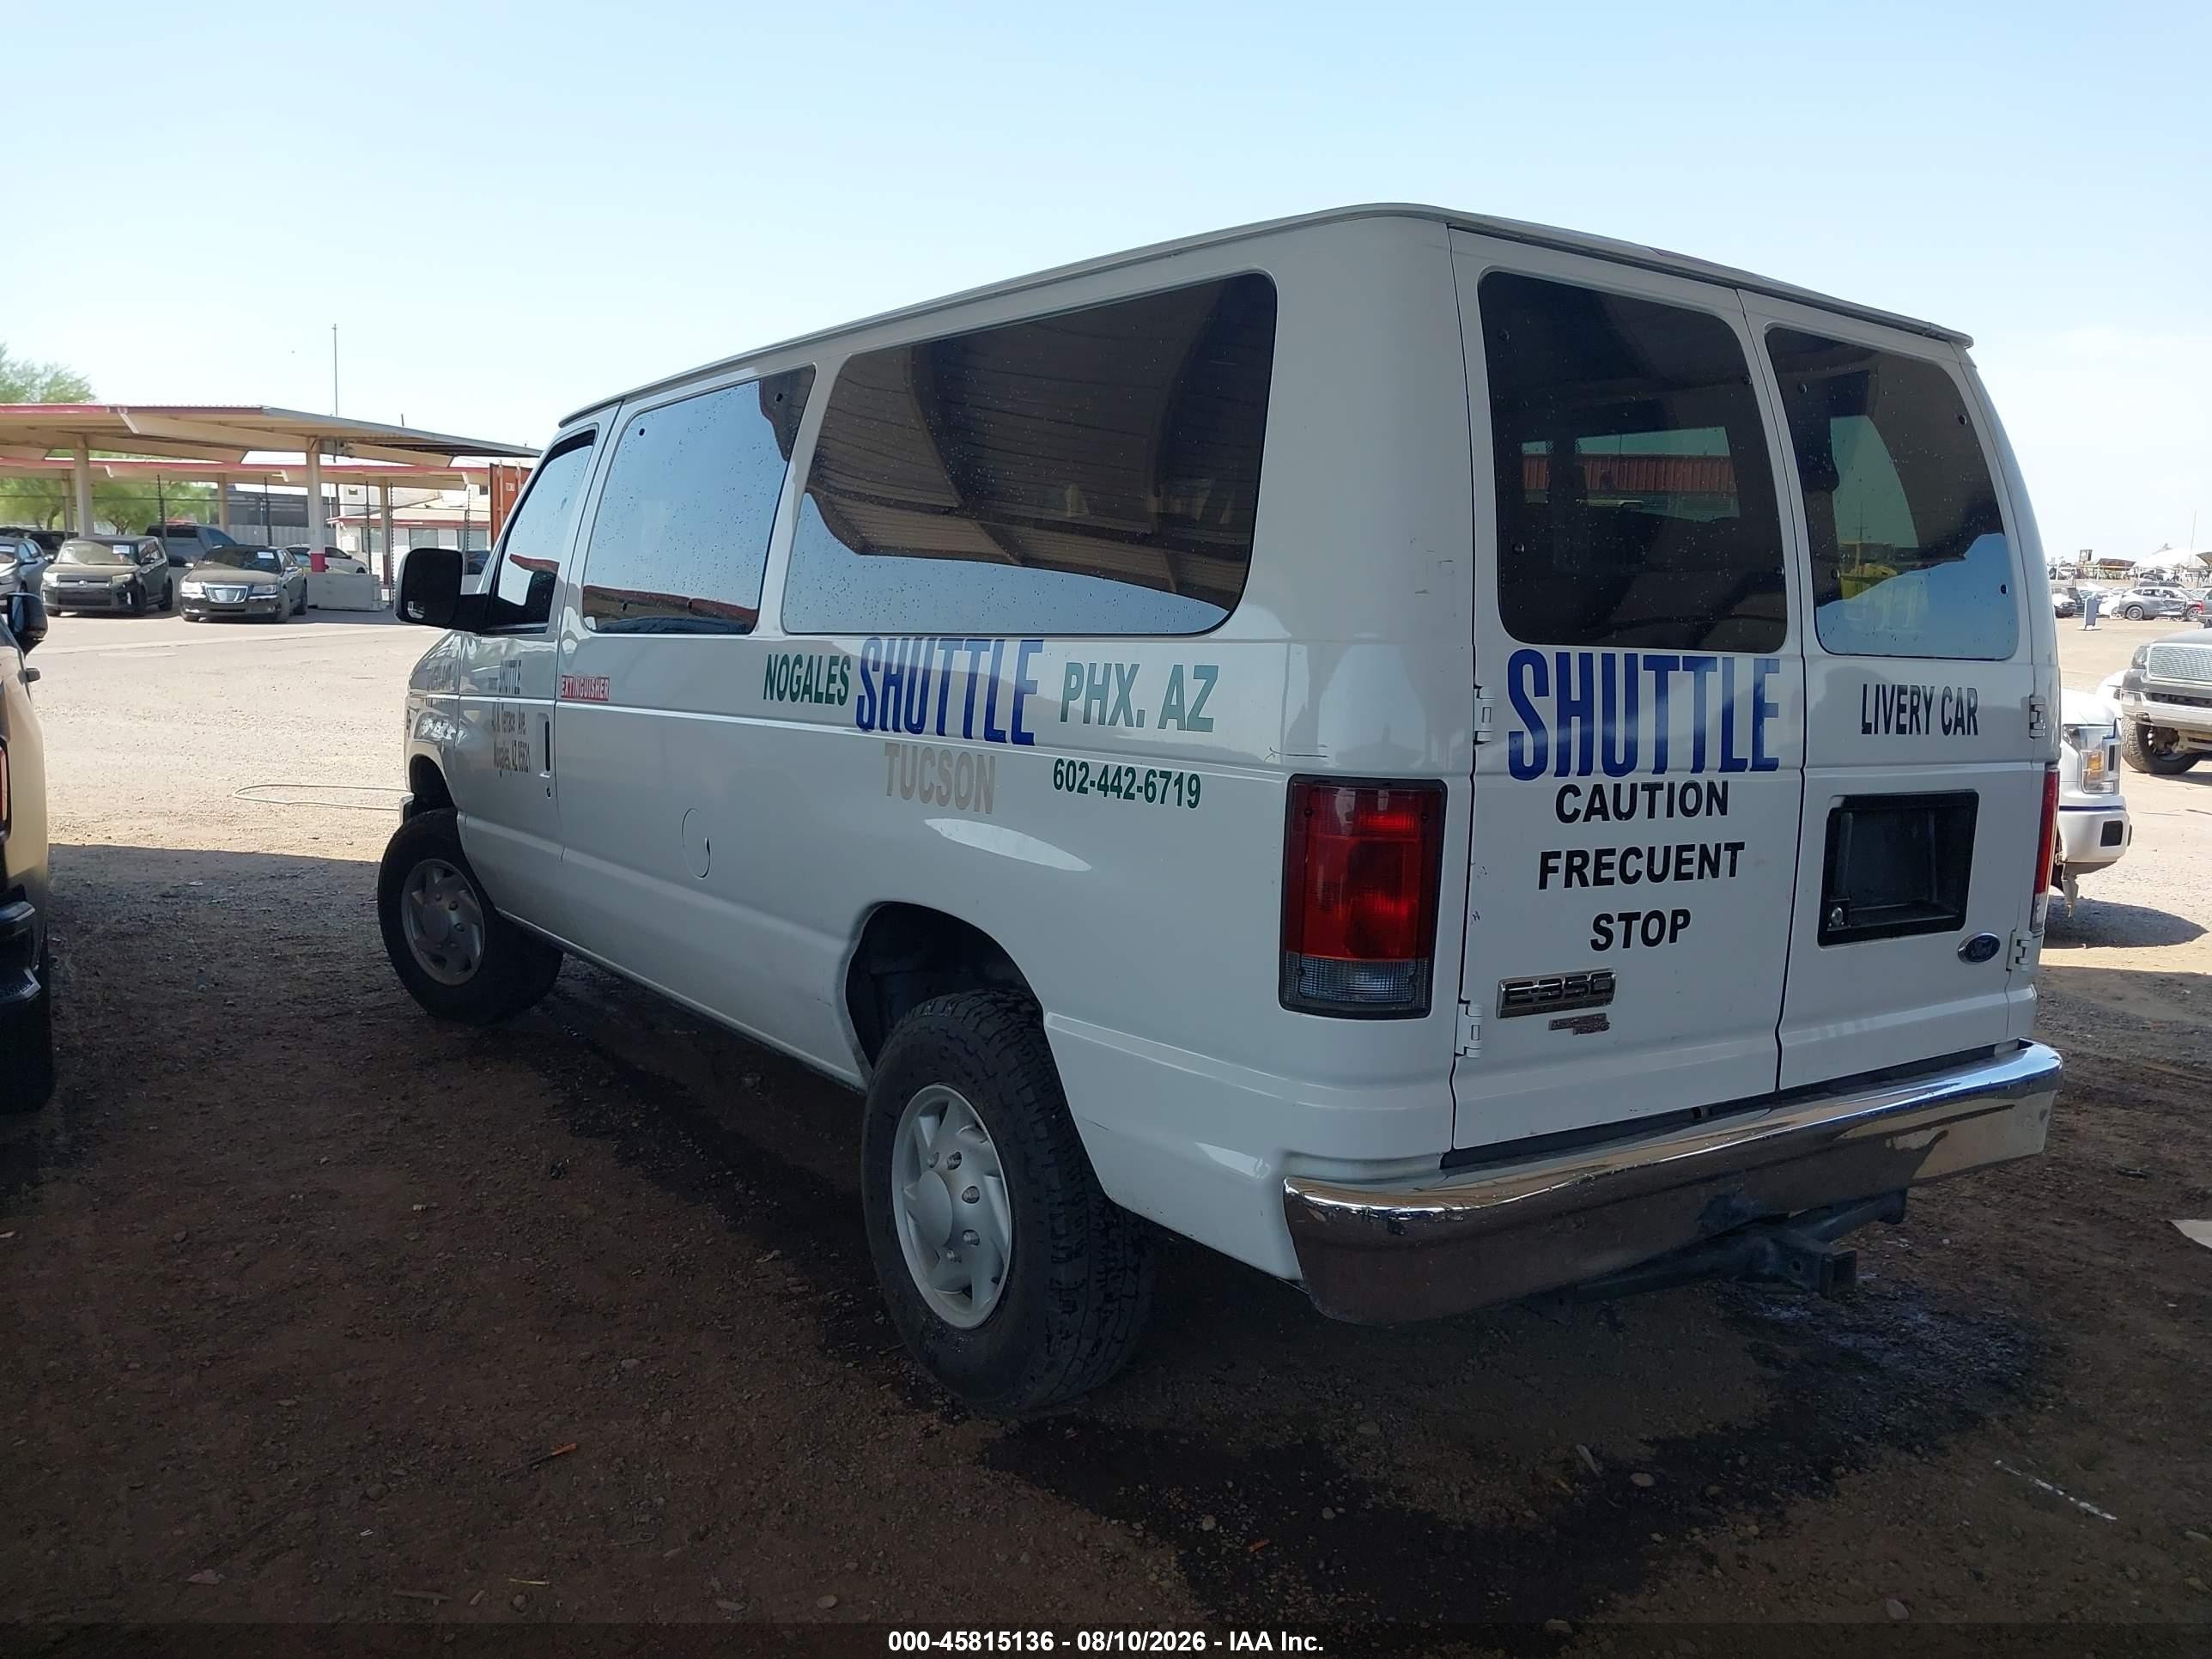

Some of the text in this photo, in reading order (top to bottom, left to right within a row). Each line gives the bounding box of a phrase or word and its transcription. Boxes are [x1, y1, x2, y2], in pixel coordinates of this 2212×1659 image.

[562, 676, 610, 701] EXTINGUISHER
[763, 636, 1220, 746] NOGALES SHUTTLE PHX. AZ
[1861, 684, 1979, 737] LIVERY CAR
[1507, 649, 1780, 781] SHUTTLE
[884, 742, 996, 815] TUCSON
[1052, 758, 1201, 810] 602-442-6719
[1554, 780, 1729, 824] CAUTION
[1538, 842, 1746, 890] FRECUENT
[1589, 908, 1692, 952] STOP
